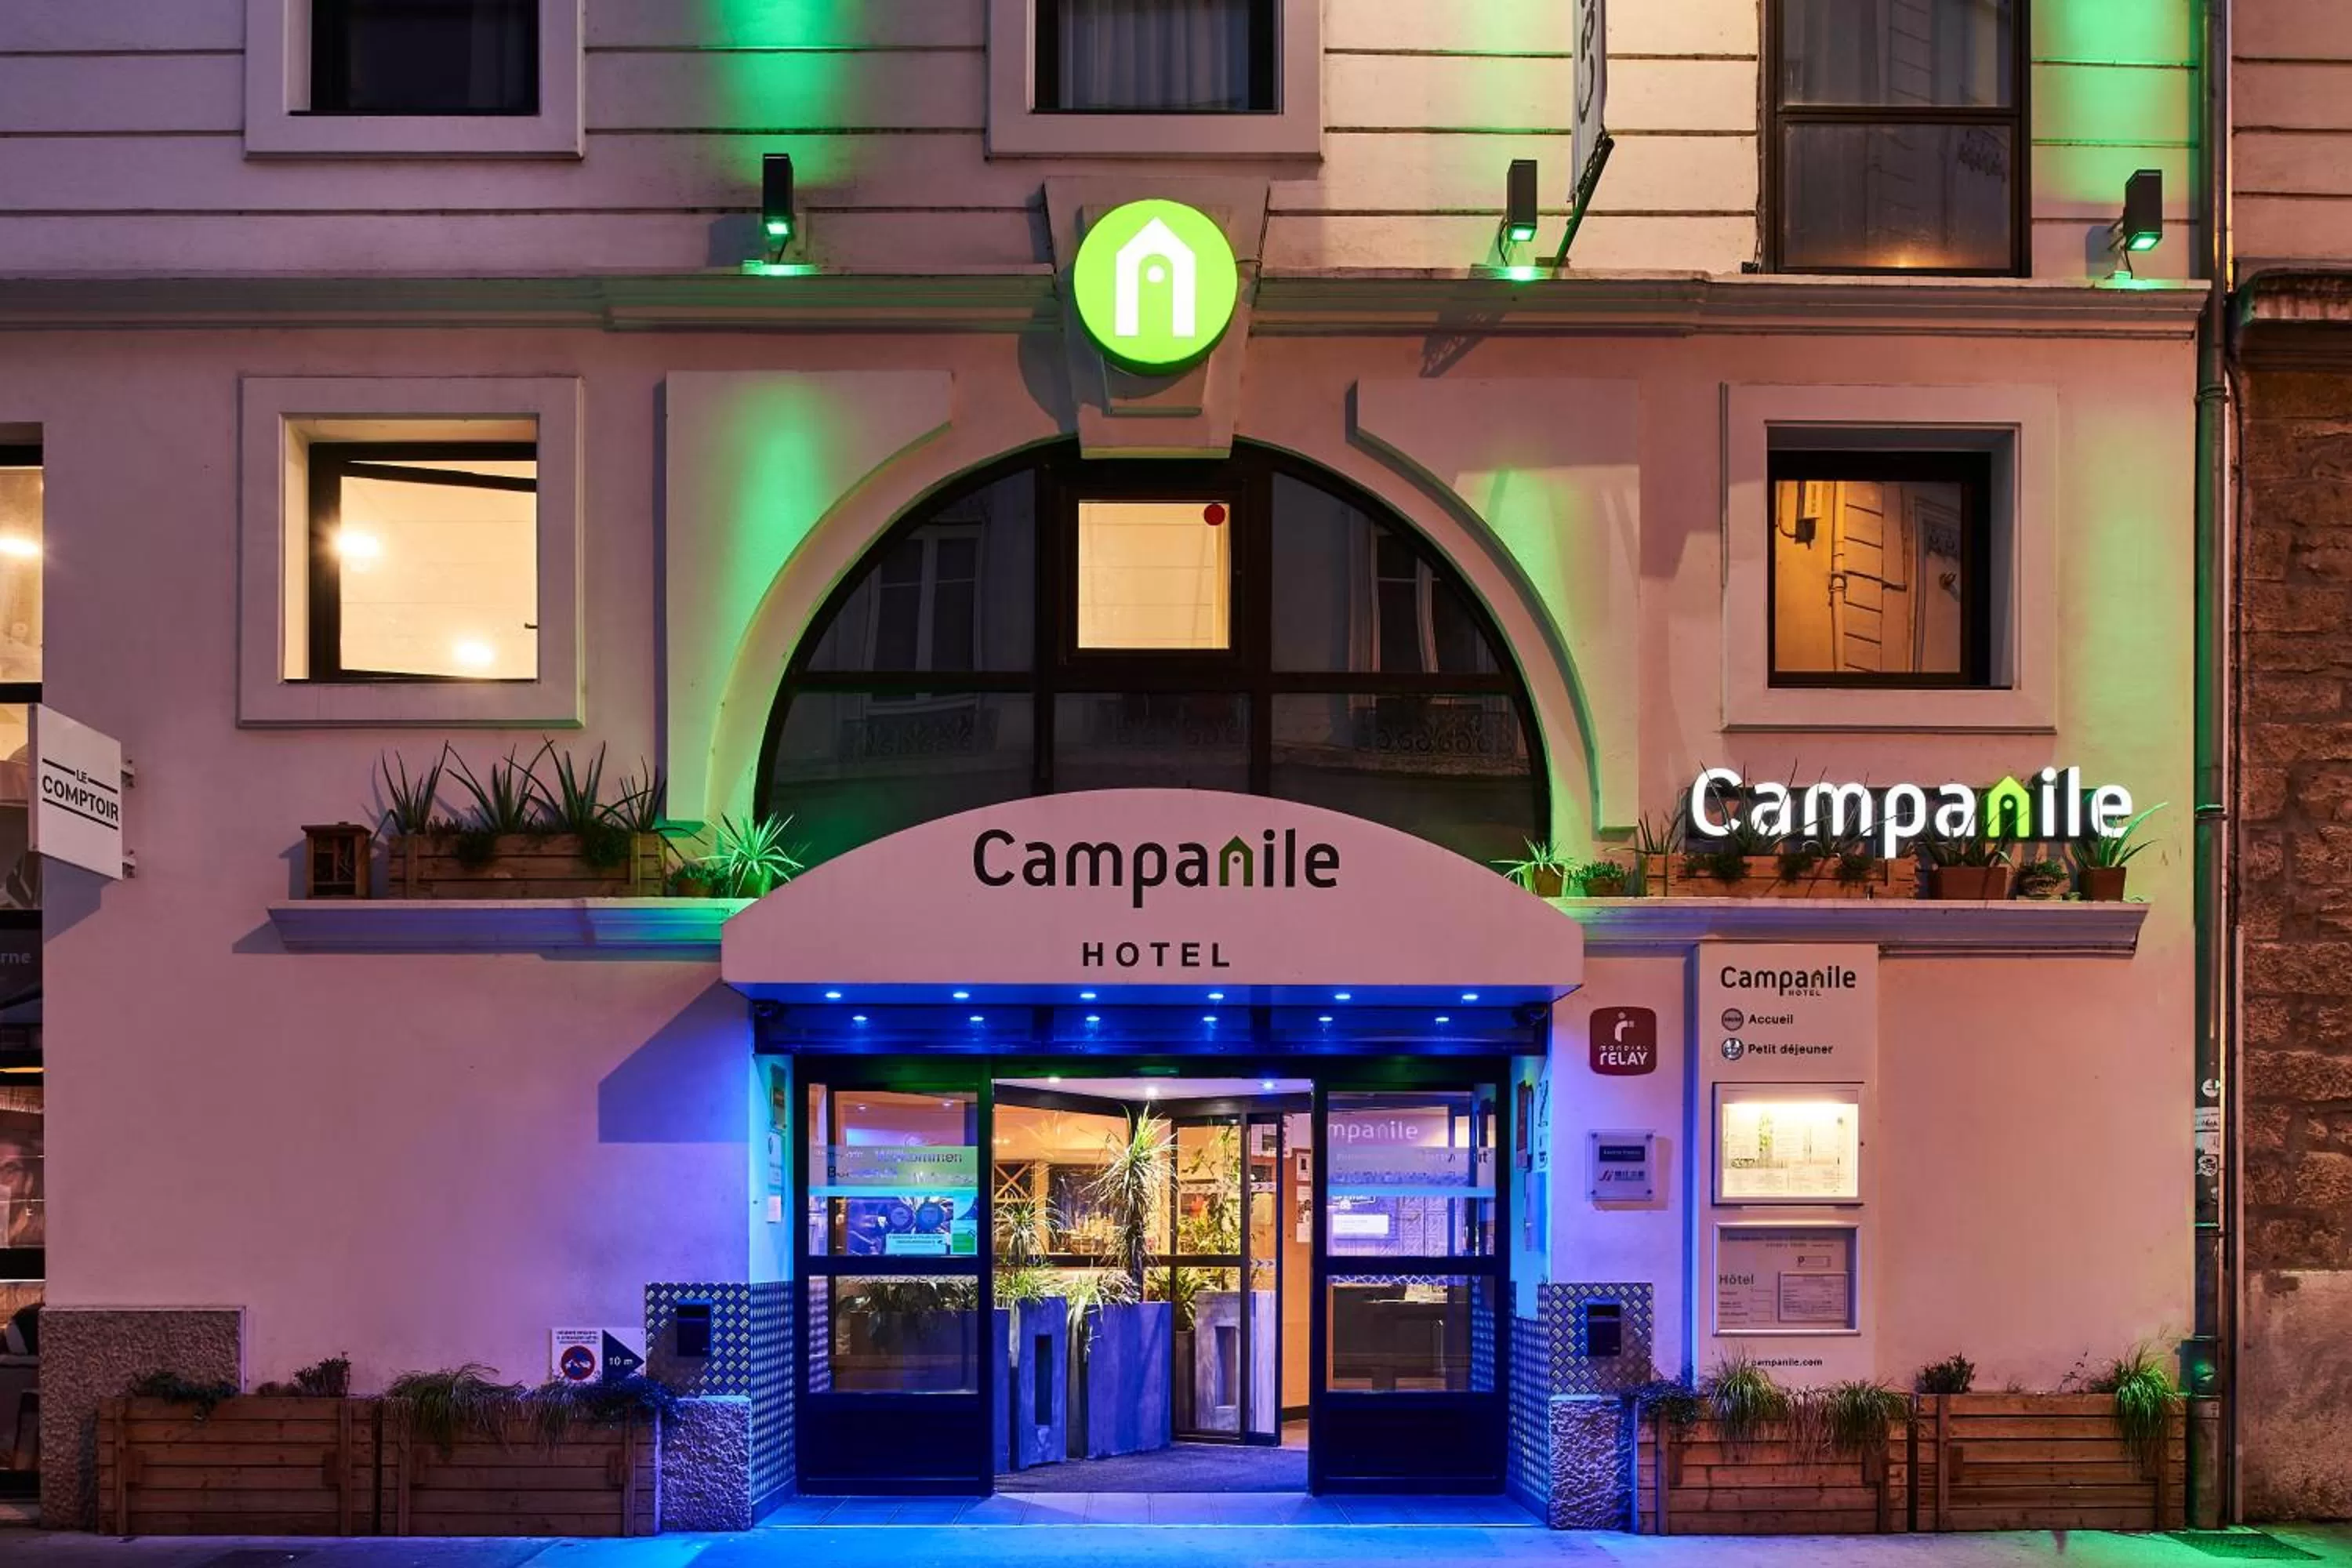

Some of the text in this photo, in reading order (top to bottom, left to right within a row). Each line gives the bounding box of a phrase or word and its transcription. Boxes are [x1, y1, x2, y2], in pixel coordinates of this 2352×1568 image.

[76, 769, 87, 784] LE
[42, 775, 118, 822] COMPTOIR
[1692, 766, 2133, 858] Campanile
[973, 828, 1340, 909] Campanile
[1082, 942, 1230, 967] HOTEL
[1721, 966, 1857, 996] Campanile
[1748, 1014, 1794, 1025] Accueil
[1748, 1044, 1833, 1055] Petit déjeuner
[608, 1356, 622, 1367] 10
